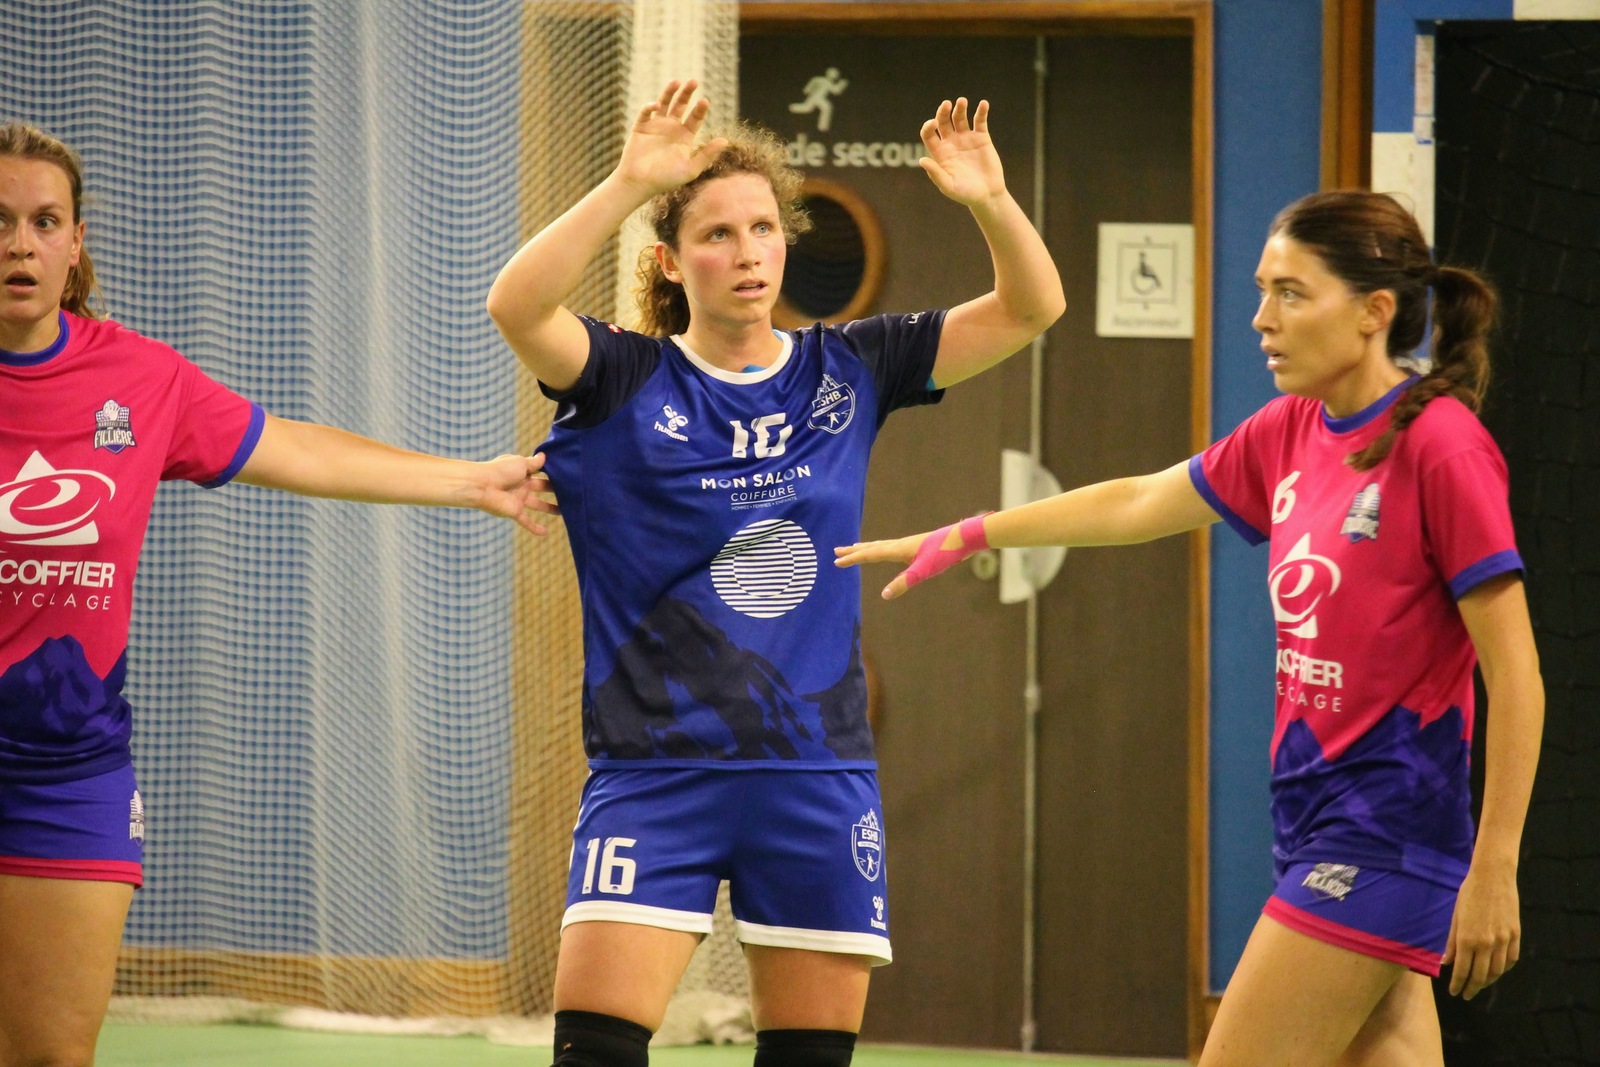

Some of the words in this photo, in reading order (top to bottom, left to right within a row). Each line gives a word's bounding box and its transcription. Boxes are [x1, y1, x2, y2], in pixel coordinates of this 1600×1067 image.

[788, 133, 826, 167] de
[833, 142, 933, 167] secou
[701, 476, 747, 490] MON
[753, 465, 812, 486] SALON
[730, 484, 795, 502] COIFFURE
[0, 590, 111, 610] YCLAGE
[581, 836, 637, 895] 16
